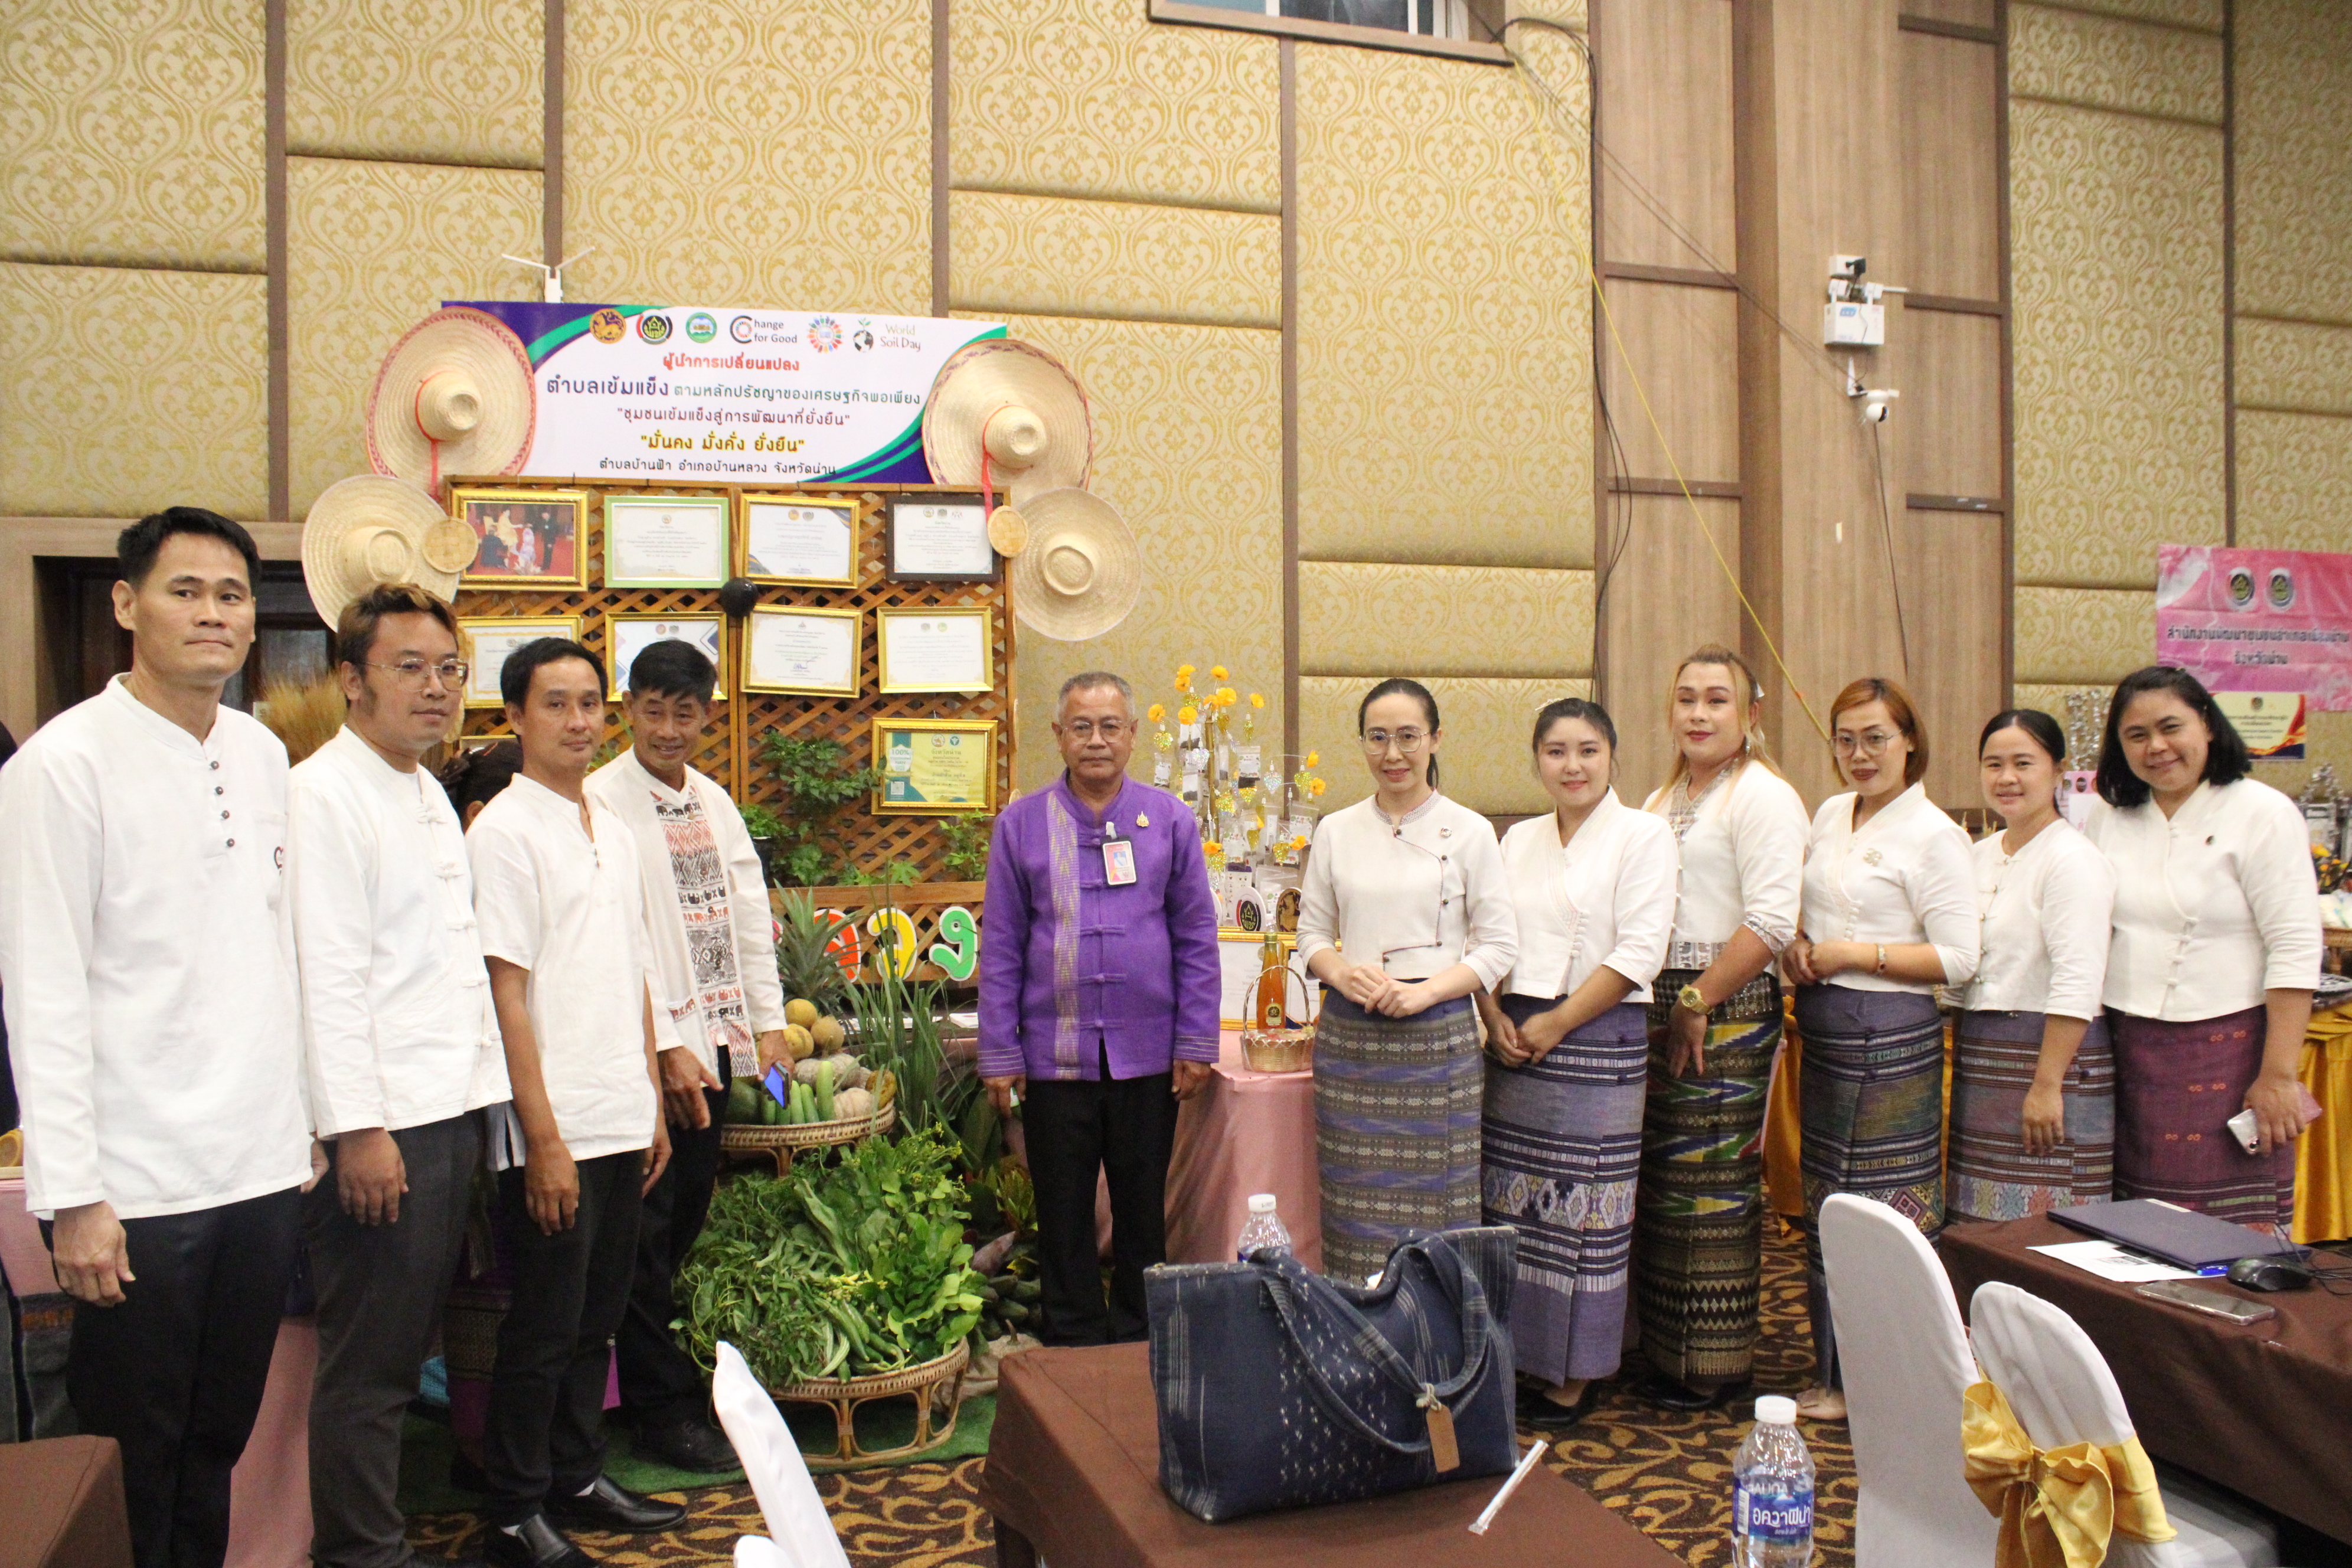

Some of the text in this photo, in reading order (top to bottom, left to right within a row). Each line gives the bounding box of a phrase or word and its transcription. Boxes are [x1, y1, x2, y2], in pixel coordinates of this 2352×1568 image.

[754, 333, 798, 344] for Good
[885, 323, 916, 337] World
[880, 337, 922, 352] Soil Day
[662, 352, 800, 371] ผู้นำการเปลี่ยนแปลง
[547, 374, 920, 404] ตำบลเข้มแข็ง ตามหลักปรัชญาของเศรษฐกิจพอเพียง
[618, 407, 850, 425] "ชุมชนเข้มแข็งสู่การพัฒนาที่ยั่งยืน"
[641, 429, 805, 453] "มั่นคง มั่งคั่ง ยั่งยืน"
[599, 457, 837, 475] ตำบลบ้านฟ้า อำเภอบ้านหลวง จังหวัดน่าน
